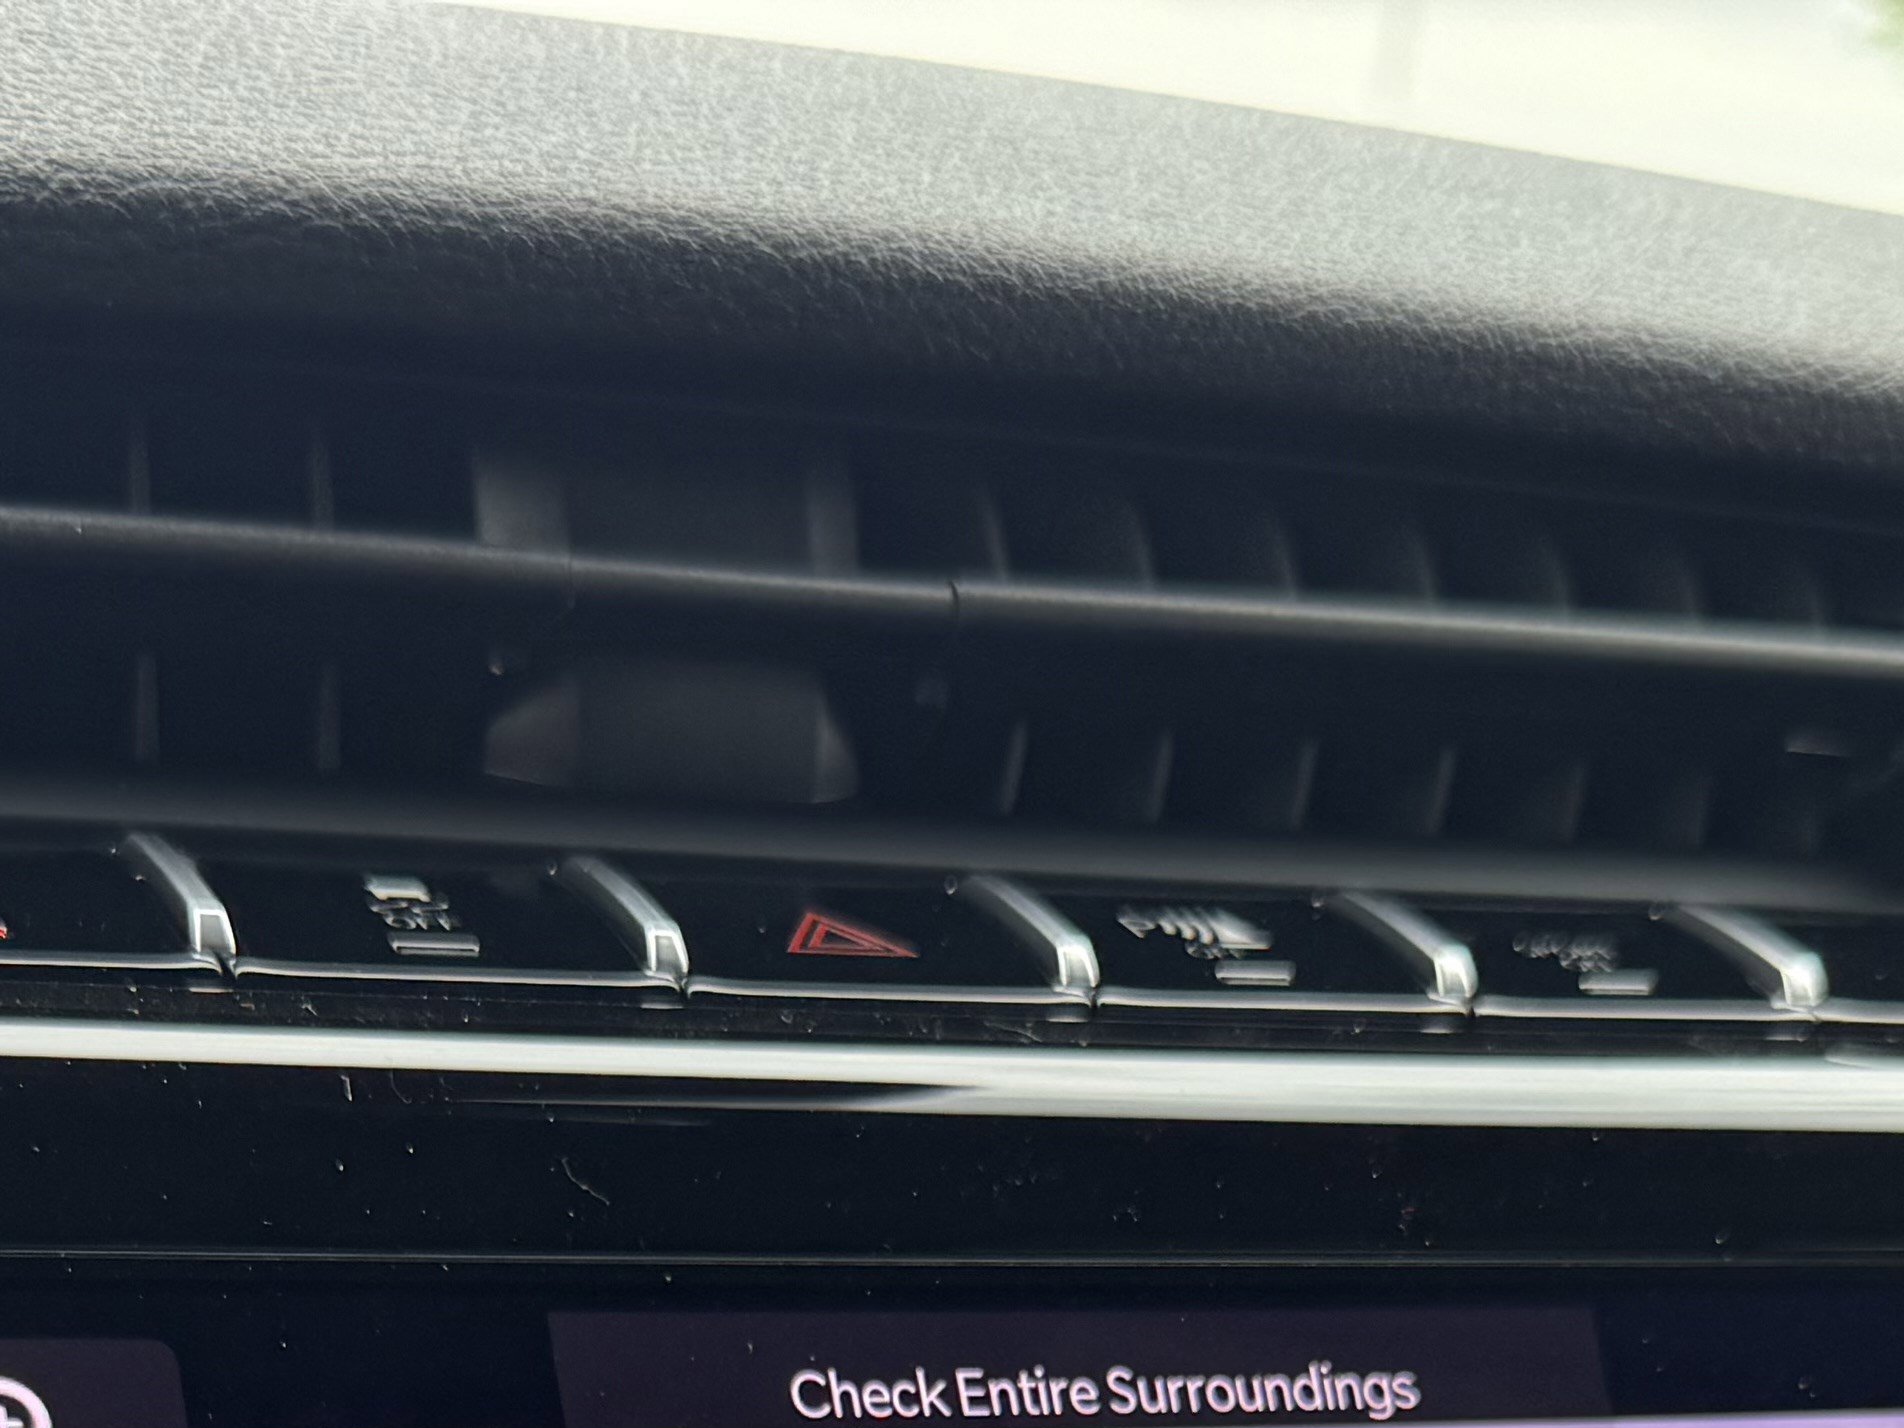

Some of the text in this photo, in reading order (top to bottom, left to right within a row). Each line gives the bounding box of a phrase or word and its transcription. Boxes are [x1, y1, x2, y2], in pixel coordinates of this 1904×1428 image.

[790, 1360, 1420, 1421] Check Entire Surroundings
